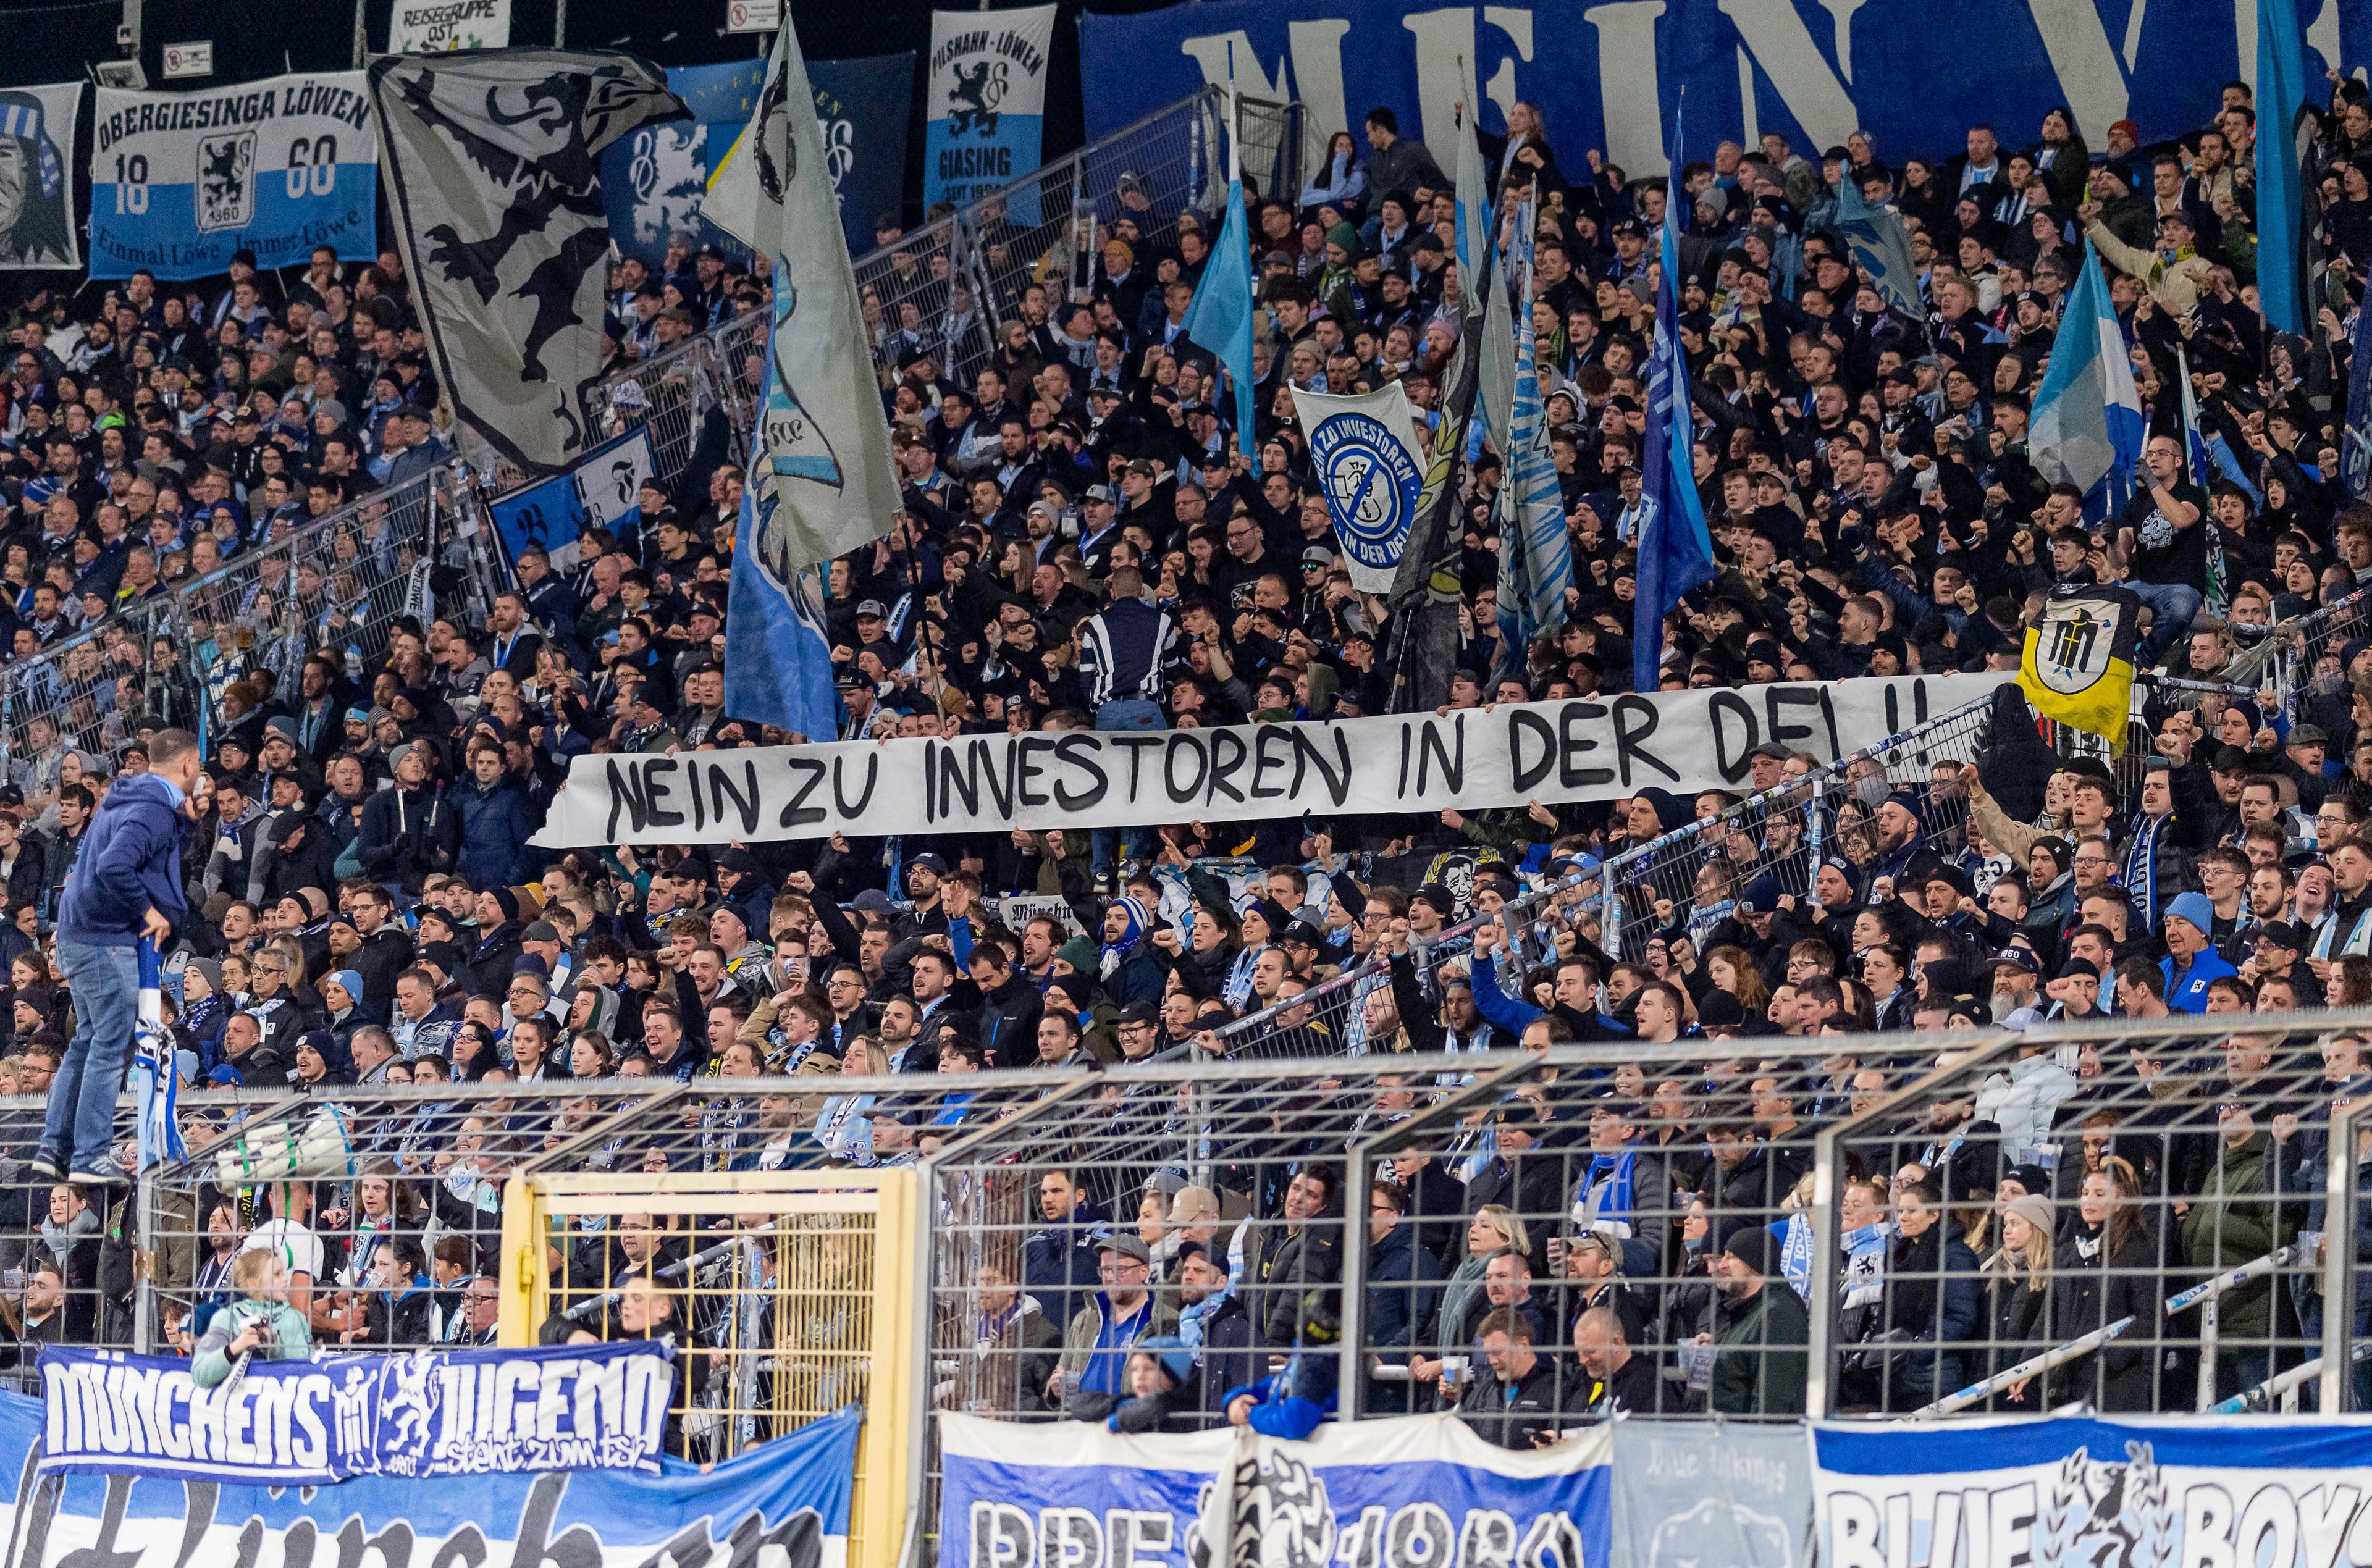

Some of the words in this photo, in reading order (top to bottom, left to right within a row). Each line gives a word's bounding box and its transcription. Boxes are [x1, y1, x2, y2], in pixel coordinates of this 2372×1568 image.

[403, 1, 496, 27] REISEGRUPPE
[428, 21, 459, 42] OST
[98, 90, 276, 153] OBERGIESINGA
[282, 80, 371, 131] LÖWEN
[116, 154, 149, 215] 18
[287, 134, 337, 199] 60
[98, 227, 164, 266] Einmal
[171, 245, 221, 266] Löwe
[236, 234, 299, 256] Immer
[302, 209, 362, 246] Löwe
[1318, 425, 1340, 451] ZU
[1336, 419, 1415, 483] INVESTOREN
[1344, 529, 1357, 555] IN
[1360, 540, 1387, 564] DER
[606, 757, 760, 844] NEIN
[780, 751, 878, 828] ZU
[925, 716, 1348, 826] INVESTOREN
[1398, 713, 1465, 800] IN
[1509, 694, 1681, 794] DER
[43, 1350, 332, 1469] MÜNCHENS
[432, 1354, 673, 1459] JUGEND
